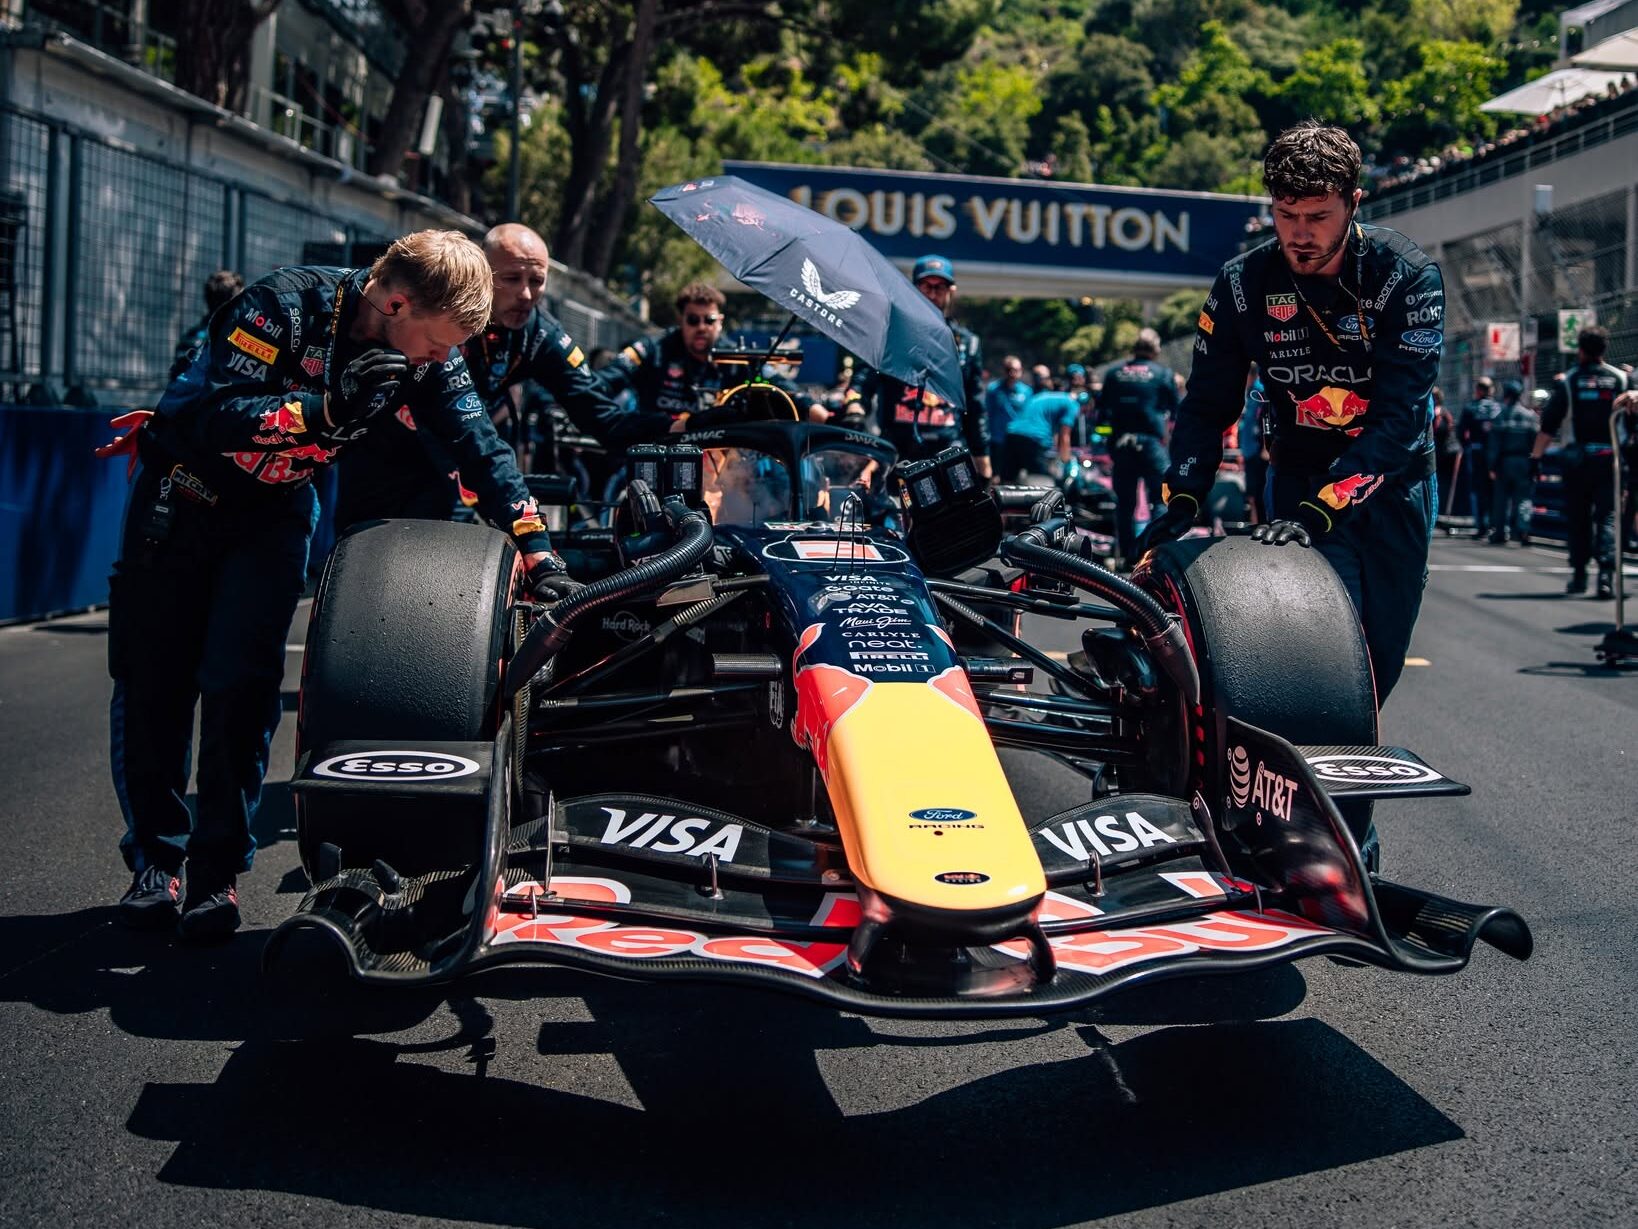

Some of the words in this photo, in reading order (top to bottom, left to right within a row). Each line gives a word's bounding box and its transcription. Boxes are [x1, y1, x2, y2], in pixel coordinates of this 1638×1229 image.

[966, 196, 1190, 254] VUITTON
[1230, 272, 1248, 313] sparco
[1374, 271, 1403, 312] sparco
[790, 288, 843, 327] CASTORE
[1269, 295, 1296, 305] TAG
[1269, 305, 1297, 320] HEUER
[245, 307, 283, 339] Mobil
[1264, 329, 1297, 343] Mobil
[1410, 331, 1436, 343] Ford
[234, 332, 275, 360] PIRELLI
[1195, 335, 1208, 355] SA
[1269, 347, 1312, 359] ARLYLE
[227, 351, 268, 382] VISA
[856, 593, 899, 601] AT&T
[602, 616, 627, 630] Hard
[839, 616, 875, 628] Maui
[875, 615, 912, 629] Jim
[841, 631, 921, 639] CARLYLE
[848, 640, 923, 649] neat.
[849, 652, 930, 660] PIRELLI
[854, 664, 913, 672] Mobil
[342, 758, 455, 775] Esso
[1315, 763, 1421, 777] Esso
[1252, 765, 1298, 822] AT&T
[924, 810, 963, 820] Ford
[600, 807, 744, 862] VISA
[1040, 811, 1177, 862] VISA
[491, 876, 860, 979] Red
